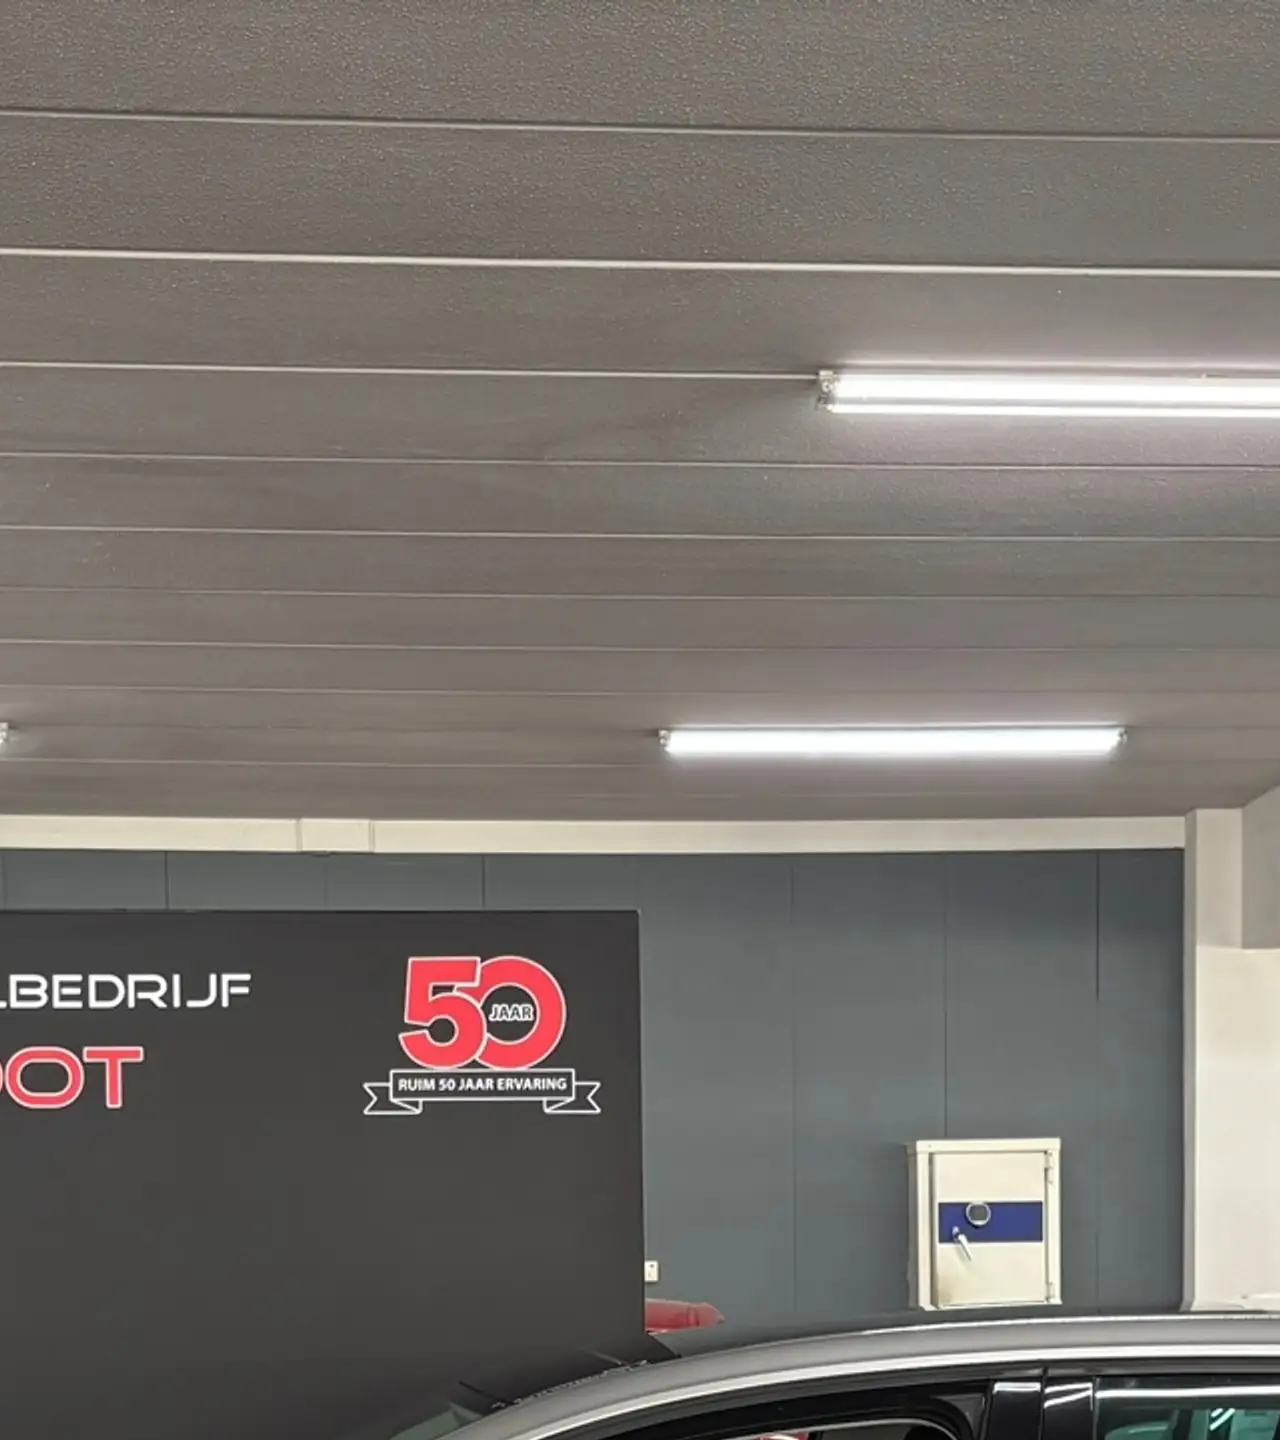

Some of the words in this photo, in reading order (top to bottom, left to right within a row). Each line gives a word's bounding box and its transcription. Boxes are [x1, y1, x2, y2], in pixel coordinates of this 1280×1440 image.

[398, 954, 567, 1070] 50
[488, 1003, 535, 1022] JAAR
[397, 1078, 436, 1092] RUIM
[438, 1078, 456, 1091] 50
[458, 1078, 494, 1092] JAAR
[496, 1077, 568, 1092] ERVARING
